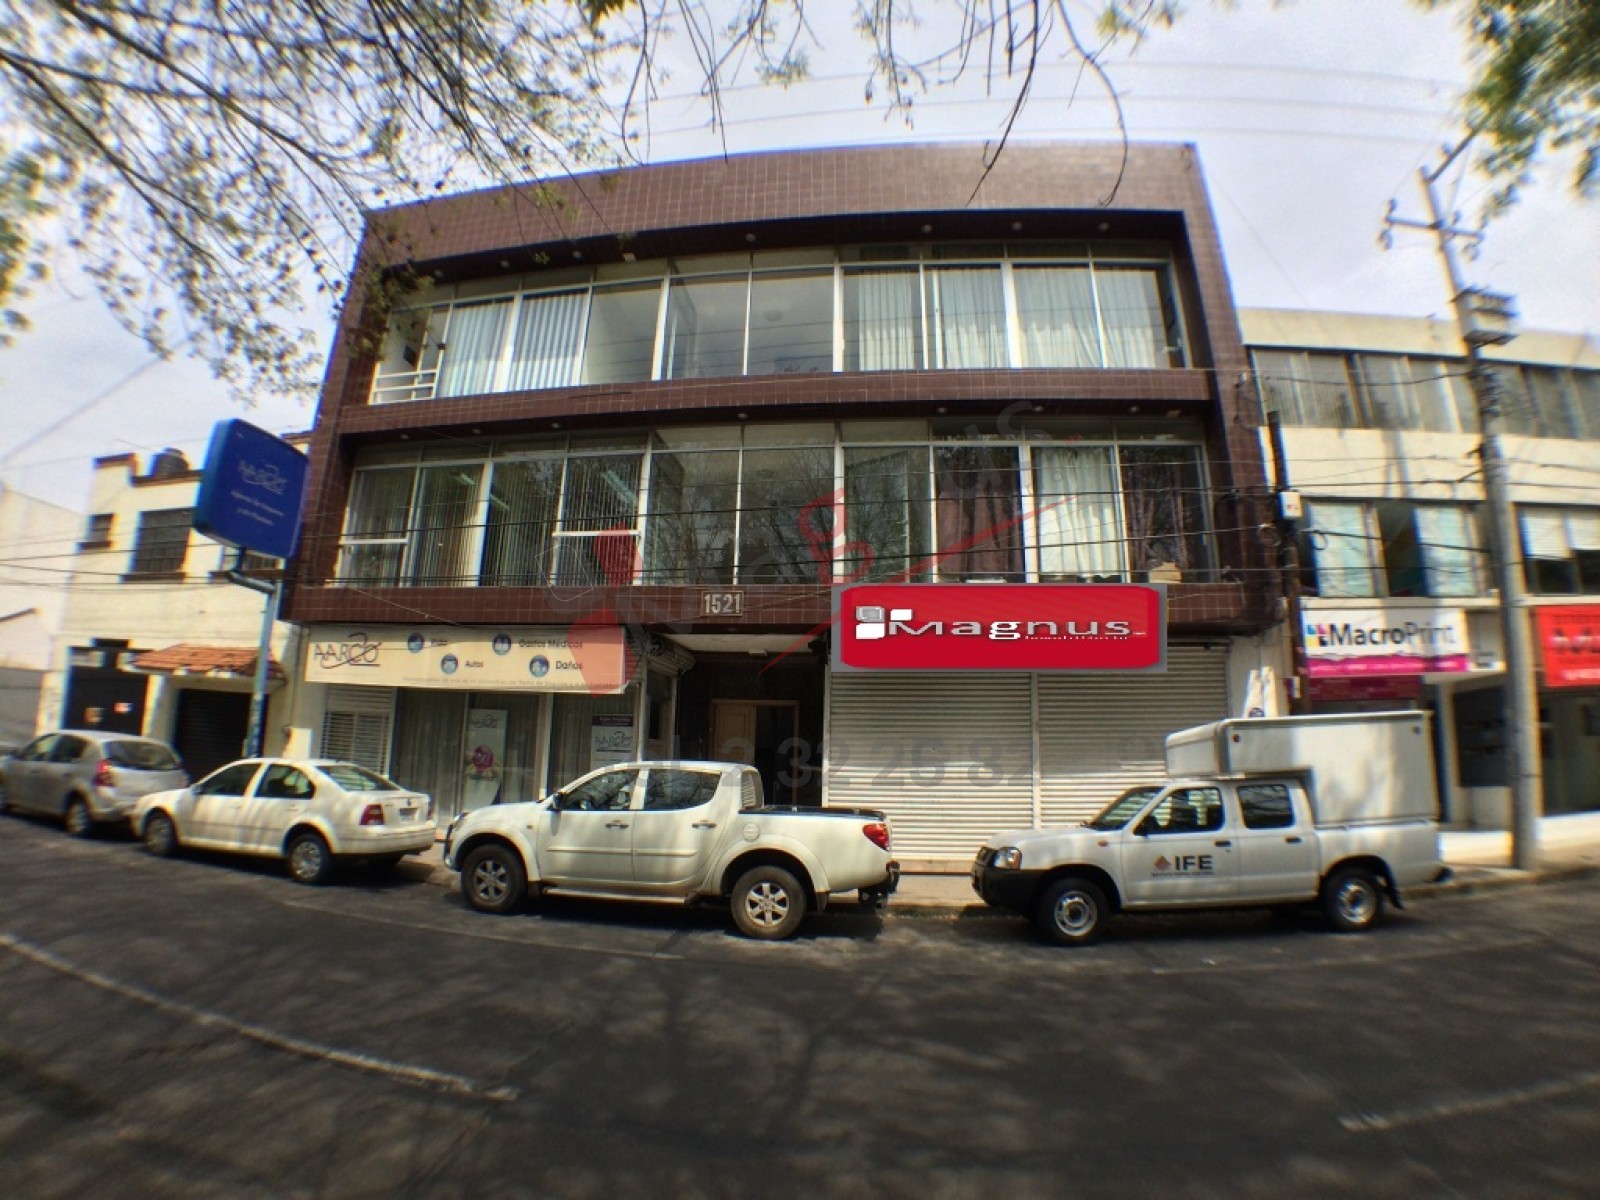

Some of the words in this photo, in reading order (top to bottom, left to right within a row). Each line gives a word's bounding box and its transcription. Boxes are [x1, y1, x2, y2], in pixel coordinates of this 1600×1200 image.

[704, 593, 741, 614] 1521
[889, 620, 1131, 639] Magnus
[1330, 622, 1456, 646] MacroPrint
[555, 659, 583, 670] Daños
[1174, 855, 1213, 870] IFE
